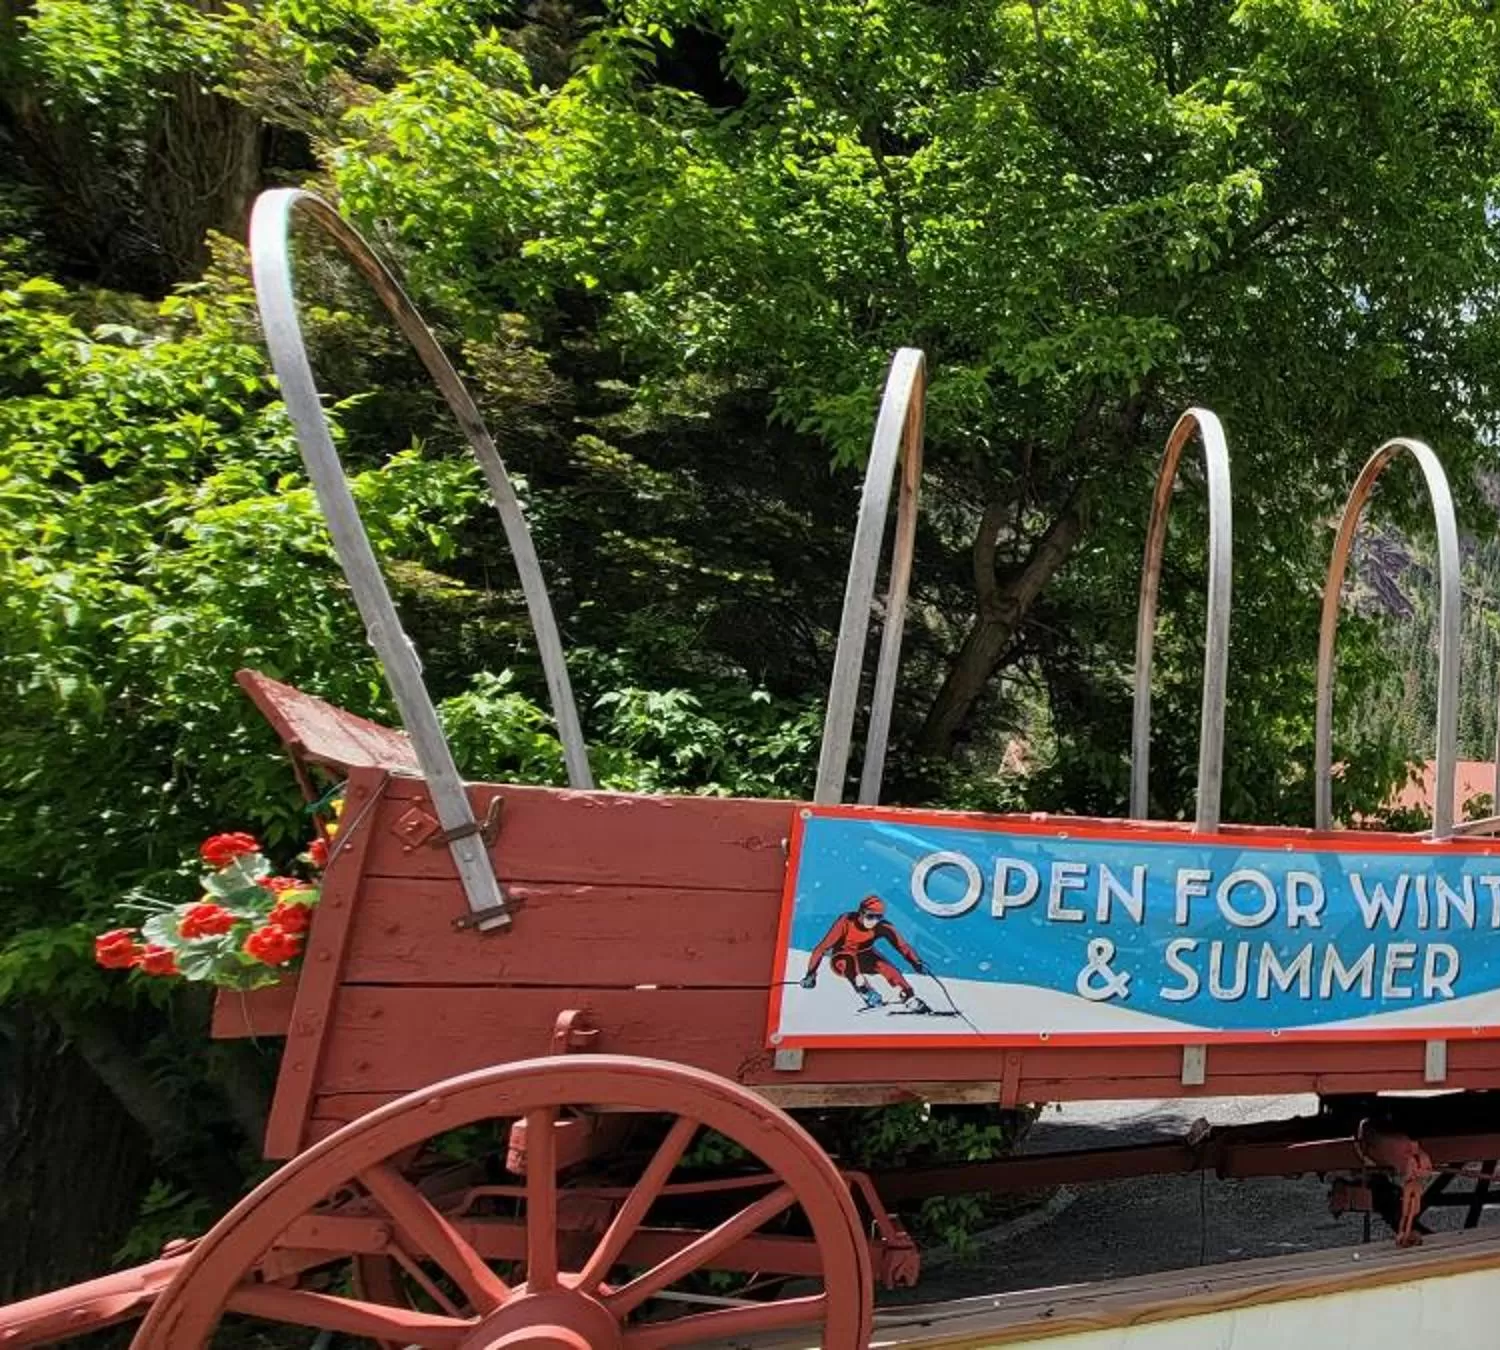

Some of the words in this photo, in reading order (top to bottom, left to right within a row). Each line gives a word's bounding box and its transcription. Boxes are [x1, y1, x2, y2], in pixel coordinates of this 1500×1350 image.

[910, 851, 1147, 924] OPEN
[1174, 868, 1326, 928] FOR
[1076, 937, 1131, 1001] &
[1160, 937, 1461, 1000] SUMMER
